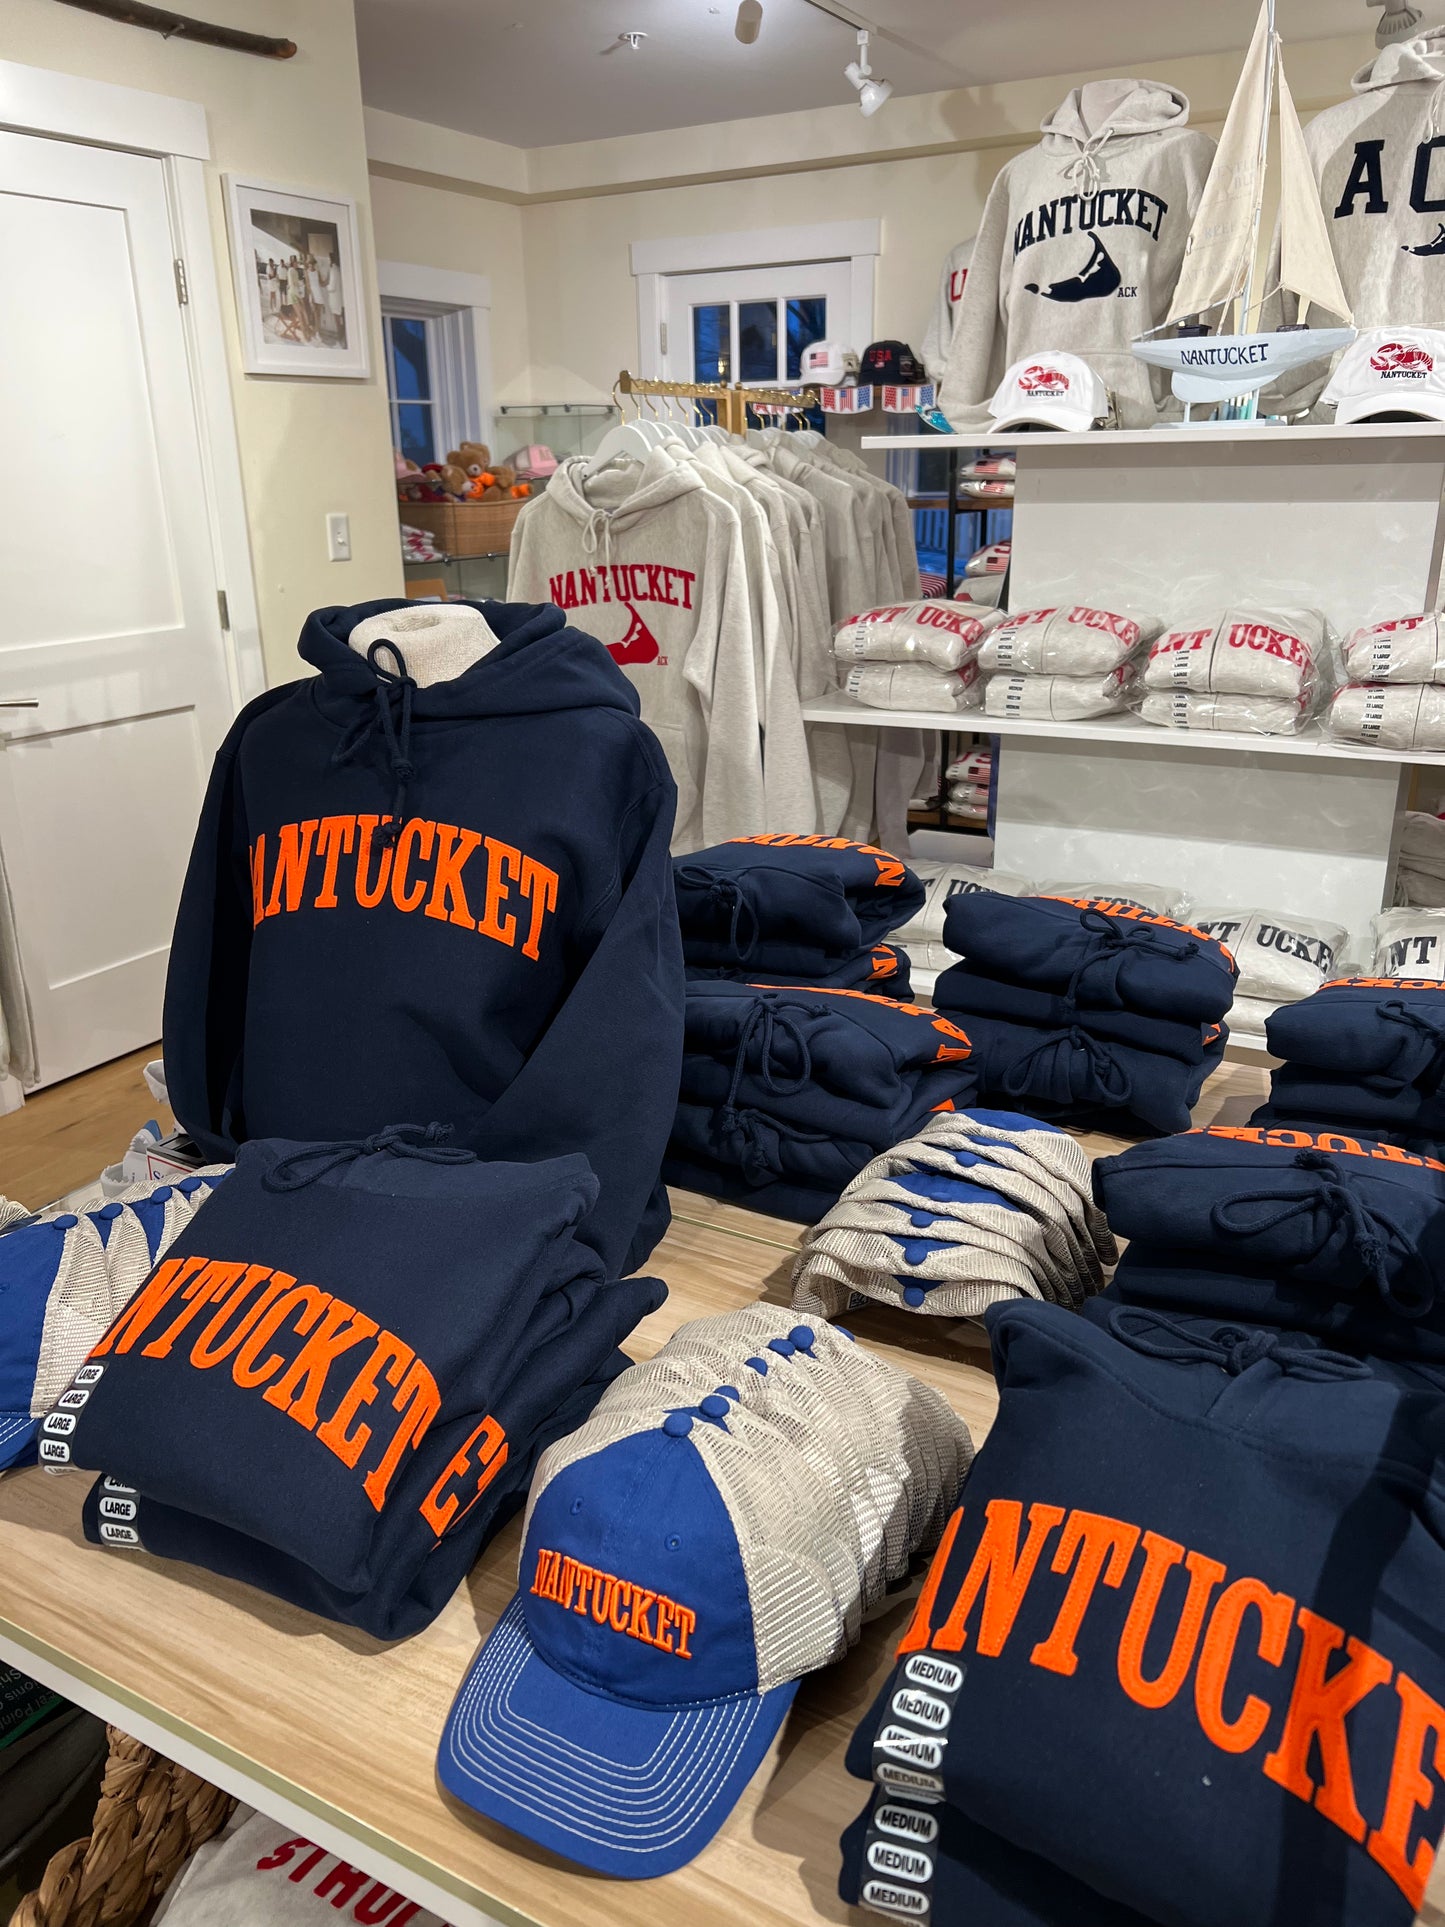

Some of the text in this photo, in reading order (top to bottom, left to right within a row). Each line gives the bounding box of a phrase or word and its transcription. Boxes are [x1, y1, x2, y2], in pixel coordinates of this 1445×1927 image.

[1117, 287, 1138, 298] ACK
[869, 350, 892, 361] USA
[1180, 343, 1269, 365] NANTUCKET
[1380, 370, 1428, 379] NANTUCKET
[549, 564, 696, 609] NANTUCKET
[657, 656, 668, 665] ACK
[249, 815, 559, 961] ANTUCKET
[78, 1367, 100, 1381] LARGE
[63, 1392, 86, 1405] LARGE
[48, 1416, 72, 1430] LARGE
[44, 1444, 65, 1458] LARGE
[105, 1501, 131, 1516] LARGE
[106, 1527, 133, 1540] LARGE
[529, 1548, 696, 1660] NANTUCKET
[909, 1660, 957, 1686] MEDIUM
[896, 1693, 945, 1724] MEDIUM
[883, 1767, 936, 1788] MEDIUM
[880, 1809, 932, 1836] MEDIUM
[873, 1847, 926, 1878] MEDIUM
[870, 1886, 922, 1910] MEDIUM
